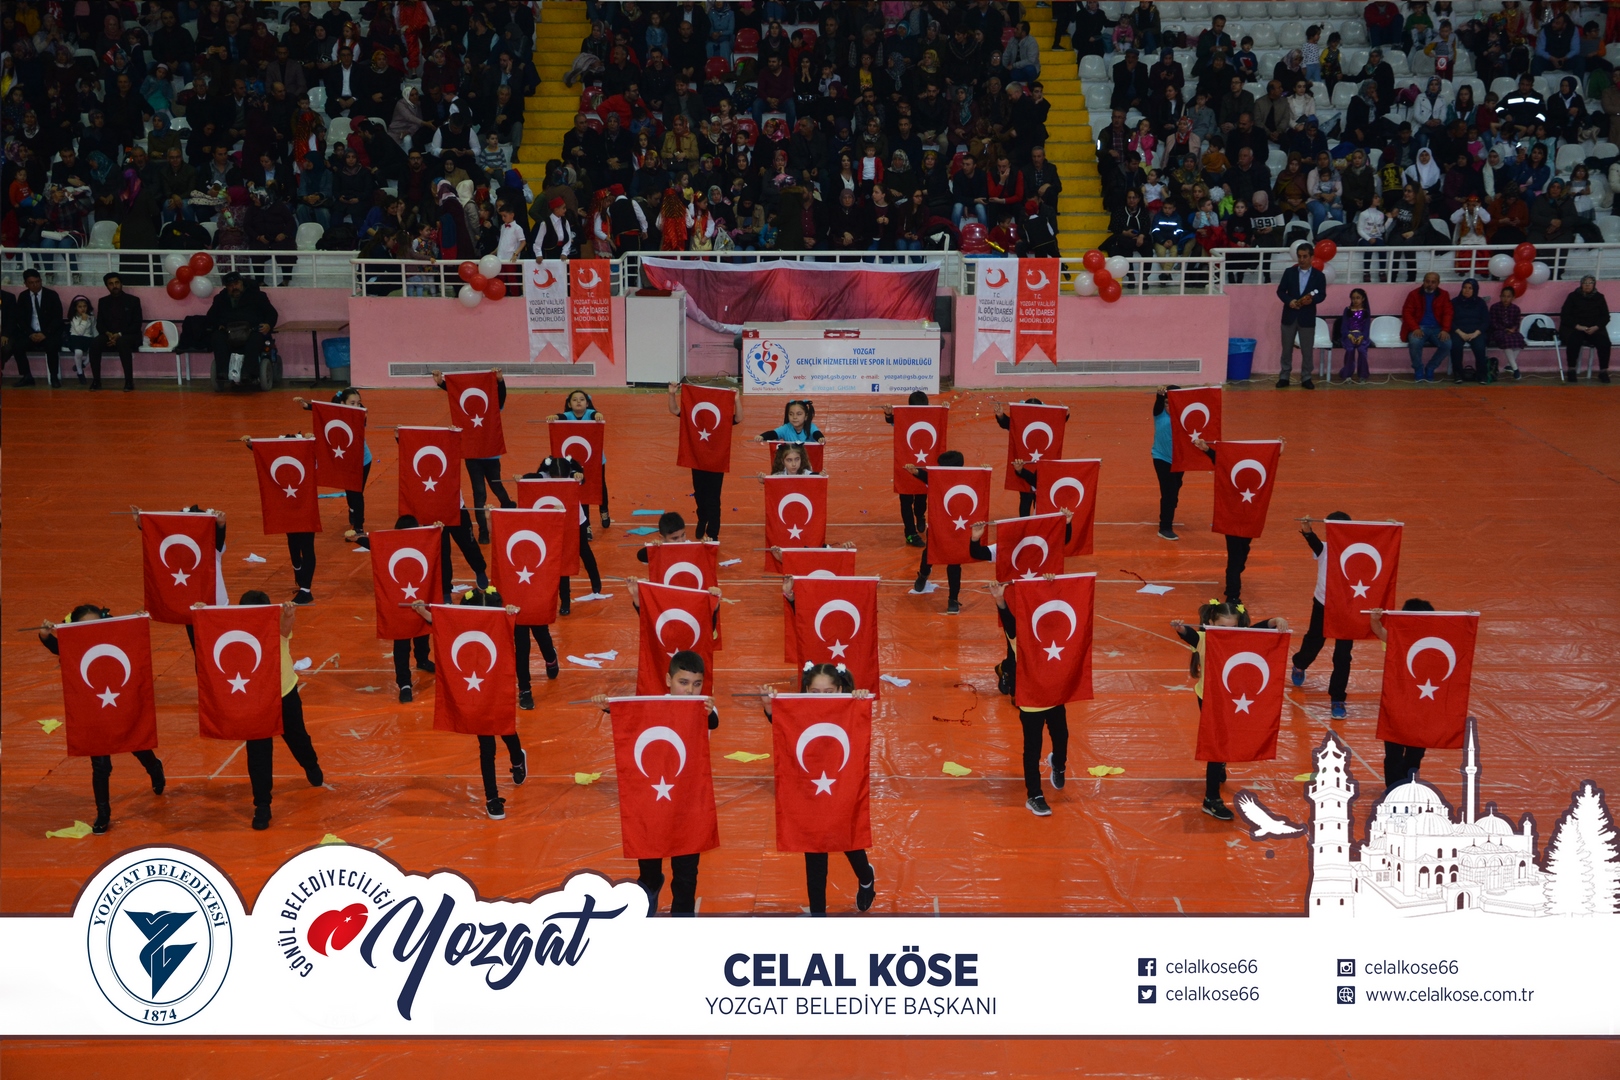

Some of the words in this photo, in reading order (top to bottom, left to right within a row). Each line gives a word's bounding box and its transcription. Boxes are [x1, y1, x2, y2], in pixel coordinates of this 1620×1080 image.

[529, 306, 534, 315] İL
[535, 306, 545, 315] GÖÇ
[546, 305, 565, 314] İDARESİ
[574, 306, 579, 314] İL
[580, 306, 589, 315] GÖÇ
[590, 306, 609, 314] İDARESİ
[978, 306, 983, 314] İL
[984, 306, 994, 315] GÖÇ
[994, 307, 1013, 315] İDARESİ
[1020, 308, 1024, 316] İL
[1025, 308, 1035, 316] GÖÇ
[1036, 308, 1055, 316] İDARESİ
[796, 357, 821, 366] GENÇLİK
[823, 357, 858, 365] HİZMETLERİ
